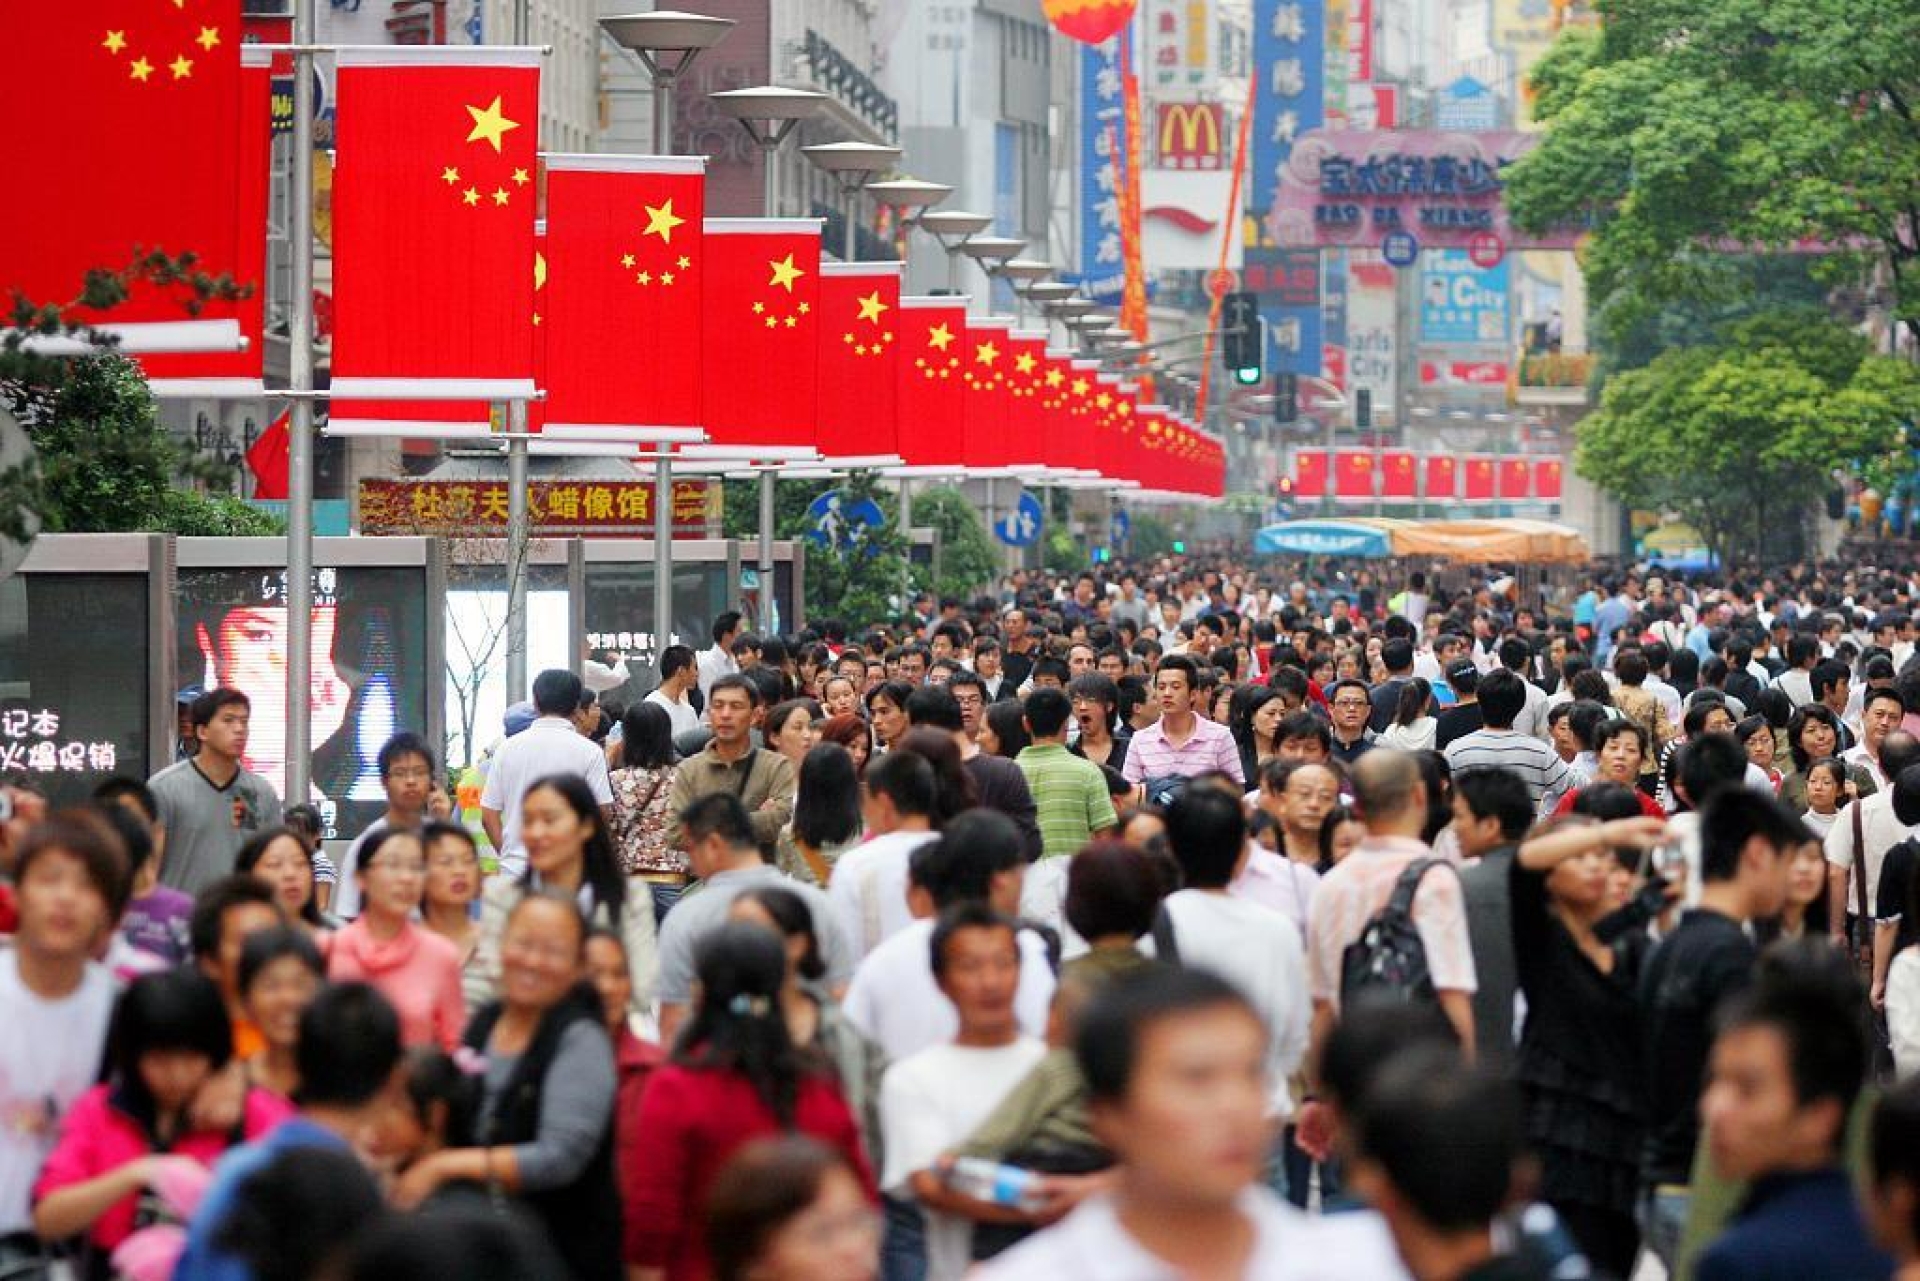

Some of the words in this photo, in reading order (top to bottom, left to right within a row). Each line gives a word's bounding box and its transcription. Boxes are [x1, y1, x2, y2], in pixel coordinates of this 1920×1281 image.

[1319, 153, 1506, 196] 宝大祥青少
[2, 708, 60, 738] 记本
